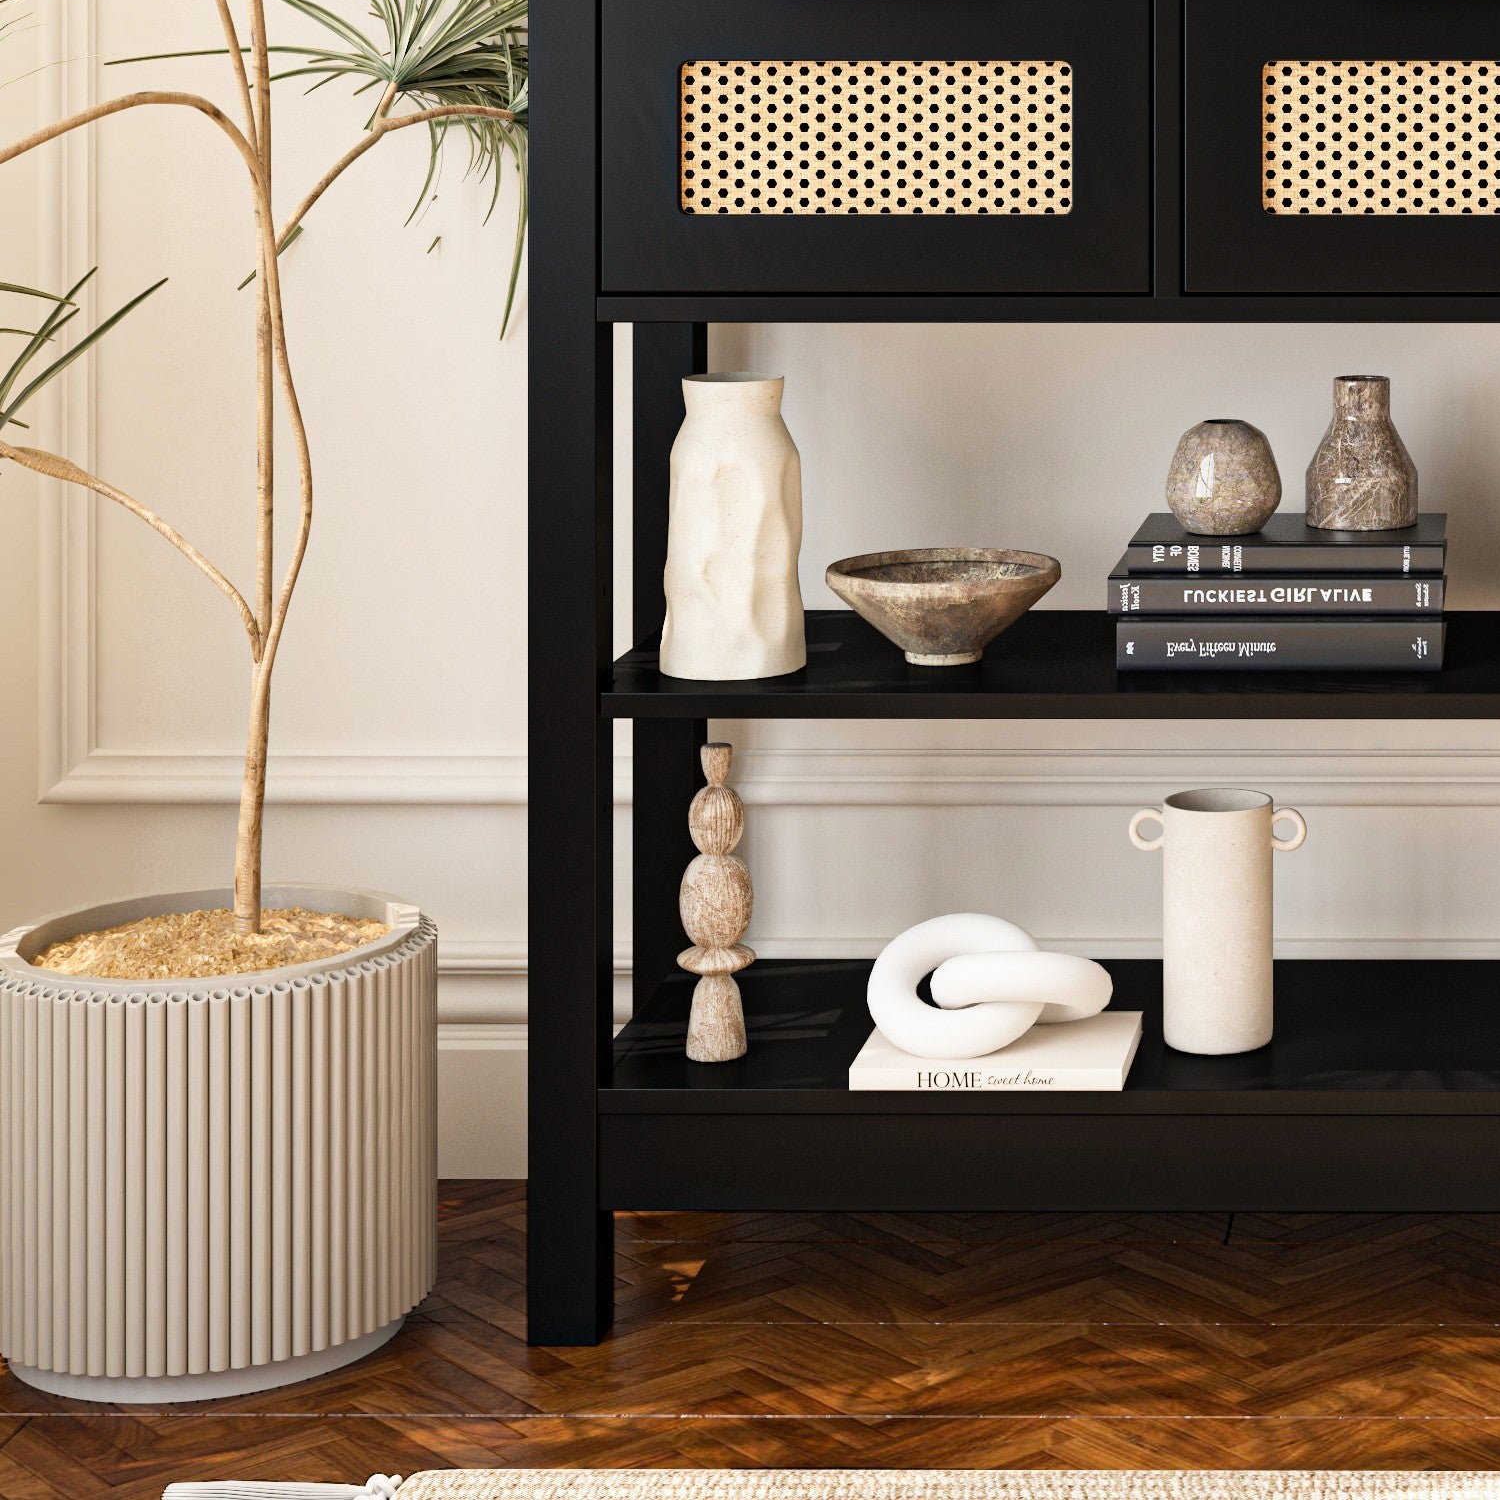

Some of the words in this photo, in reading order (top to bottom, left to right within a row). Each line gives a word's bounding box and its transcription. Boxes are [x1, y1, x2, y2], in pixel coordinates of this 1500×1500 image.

[917, 1072, 982, 1088] HOME
[987, 1073, 1022, 1086] sweet
[1023, 1070, 1056, 1086] home
